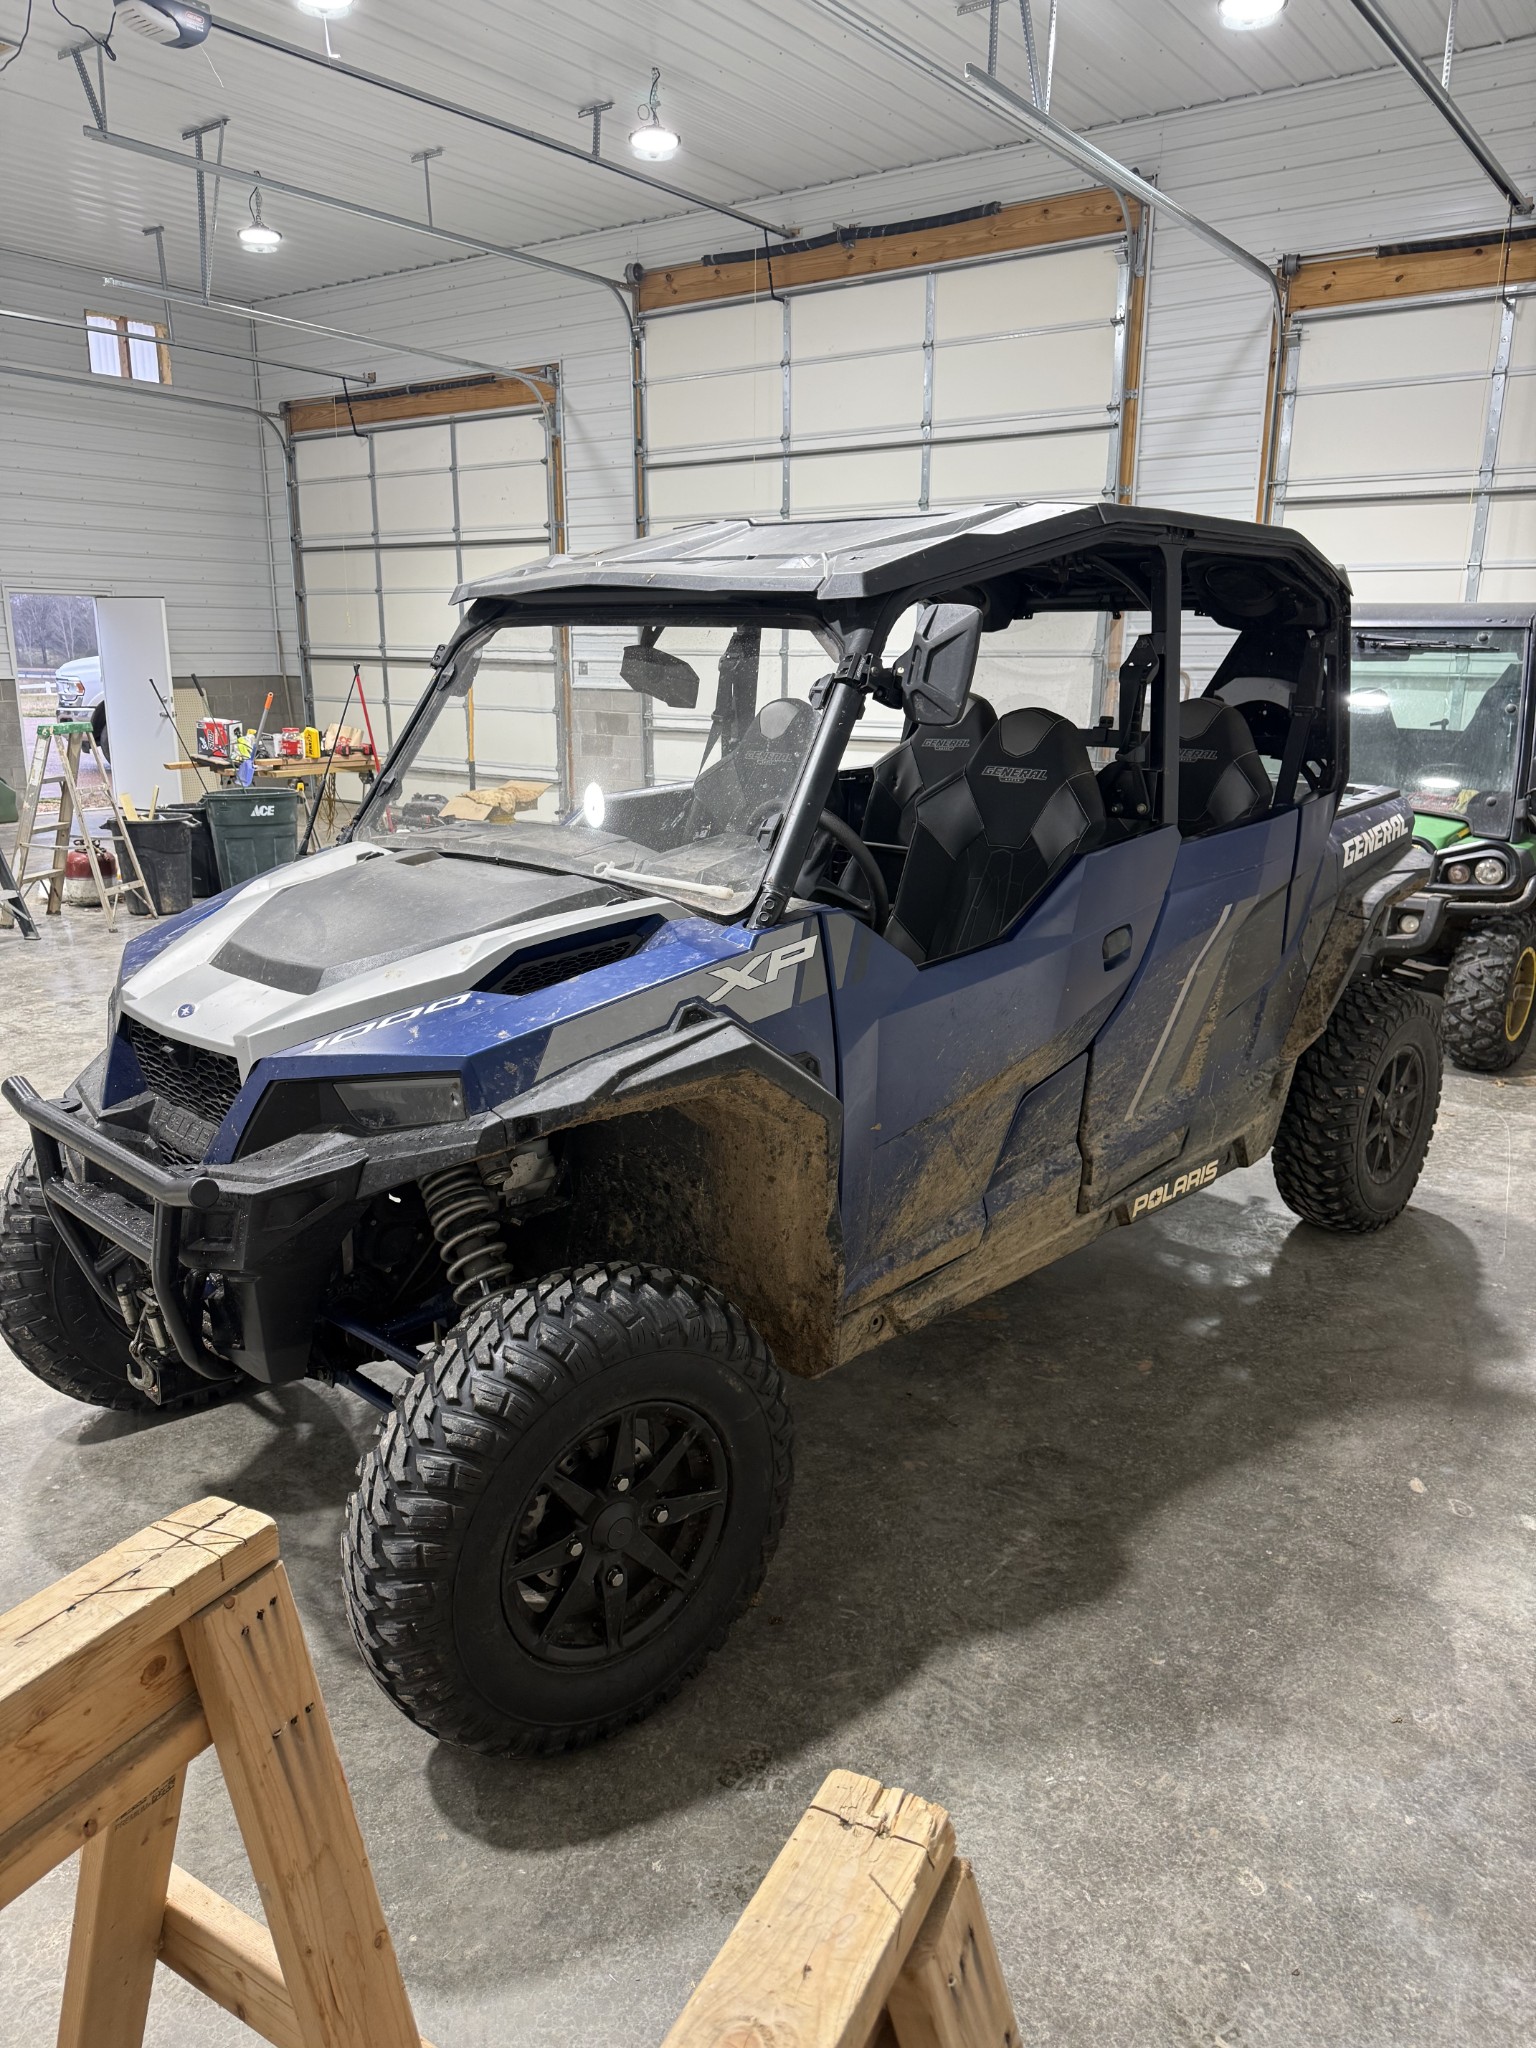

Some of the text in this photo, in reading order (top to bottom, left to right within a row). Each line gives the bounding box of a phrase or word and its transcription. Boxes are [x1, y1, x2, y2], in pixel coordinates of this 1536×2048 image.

[921, 738, 970, 748] GENERAL
[981, 765, 1048, 781] GENERAL
[250, 804, 275, 817] ACE
[1342, 813, 1409, 869] GENERAL
[704, 934, 818, 1004] XP
[310, 992, 473, 1053] 1000
[1131, 1159, 1220, 1219] POLARIS
